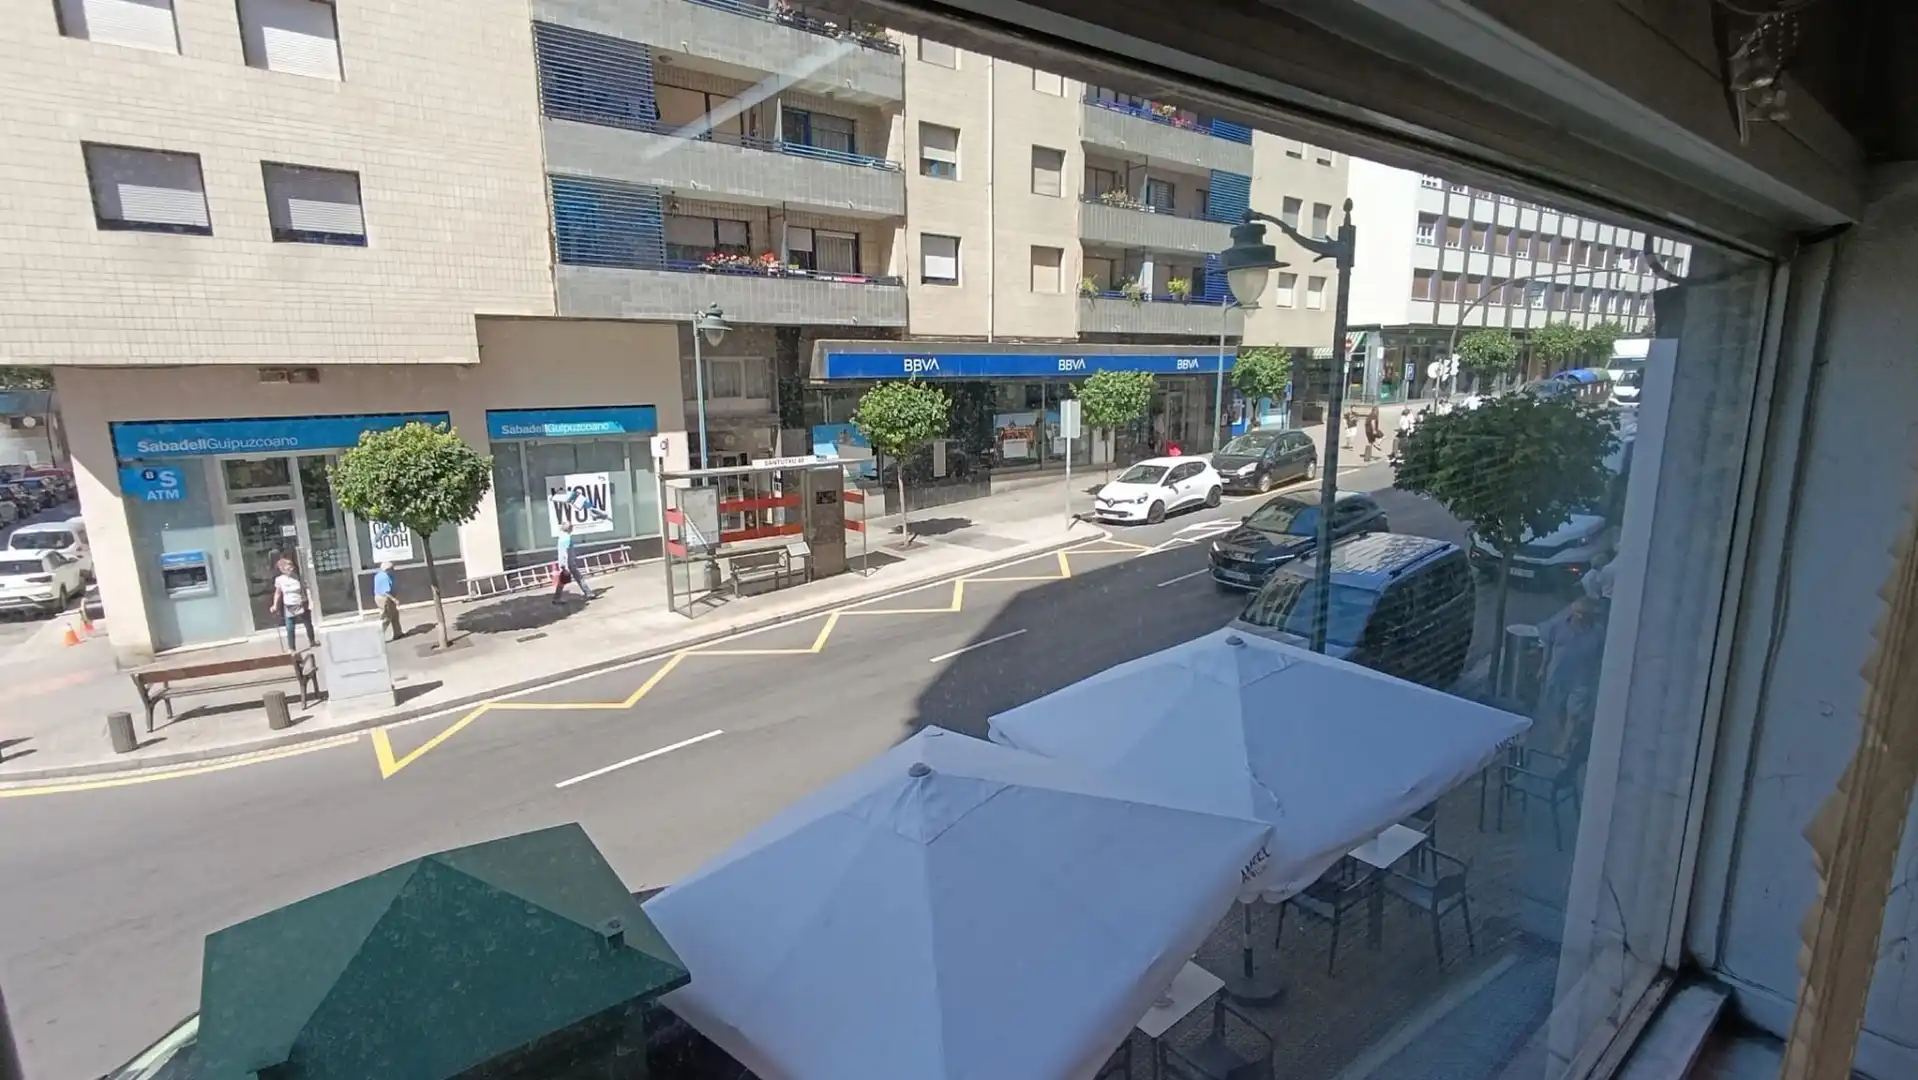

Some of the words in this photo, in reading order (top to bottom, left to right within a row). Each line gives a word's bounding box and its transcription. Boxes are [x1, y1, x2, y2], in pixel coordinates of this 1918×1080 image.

[903, 358, 940, 372] BBVA
[1058, 358, 1086, 371] BBVA
[1177, 358, 1200, 370] BBVA
[146, 489, 180, 501] ATM
